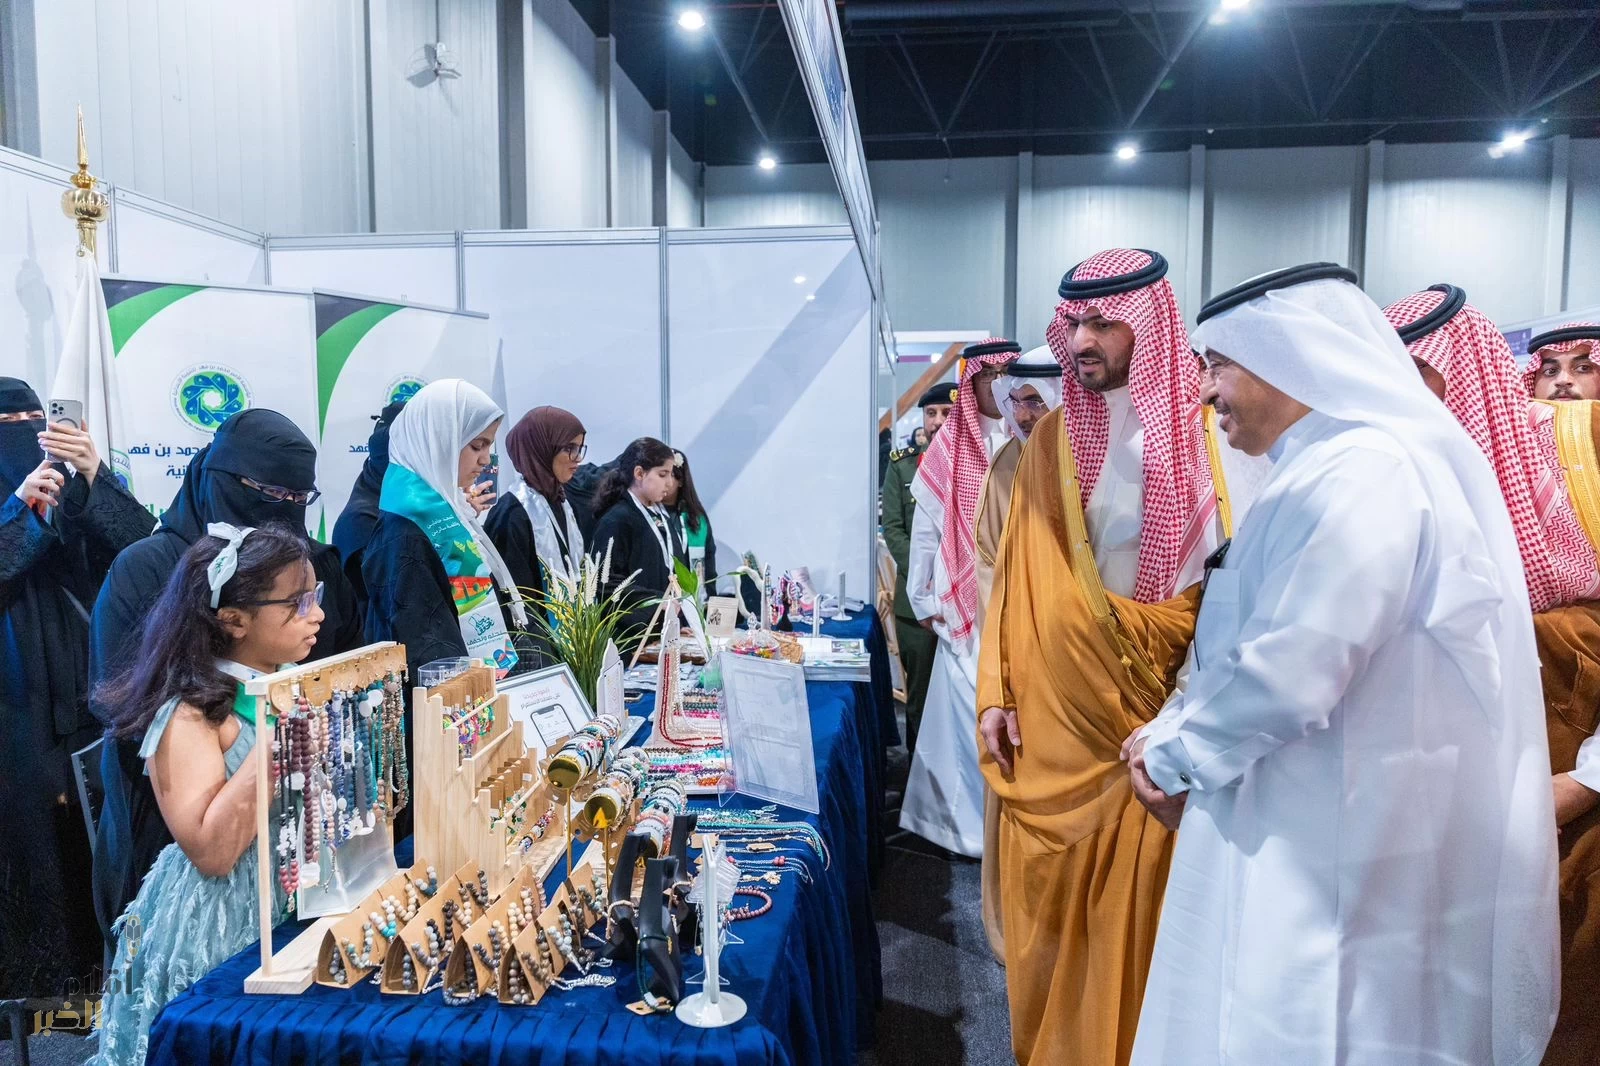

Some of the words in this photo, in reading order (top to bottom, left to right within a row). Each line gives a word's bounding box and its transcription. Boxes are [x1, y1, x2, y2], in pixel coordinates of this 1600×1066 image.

[127, 443, 150, 454] فه
[155, 443, 170, 457] بن
[176, 446, 200, 456] حمد
